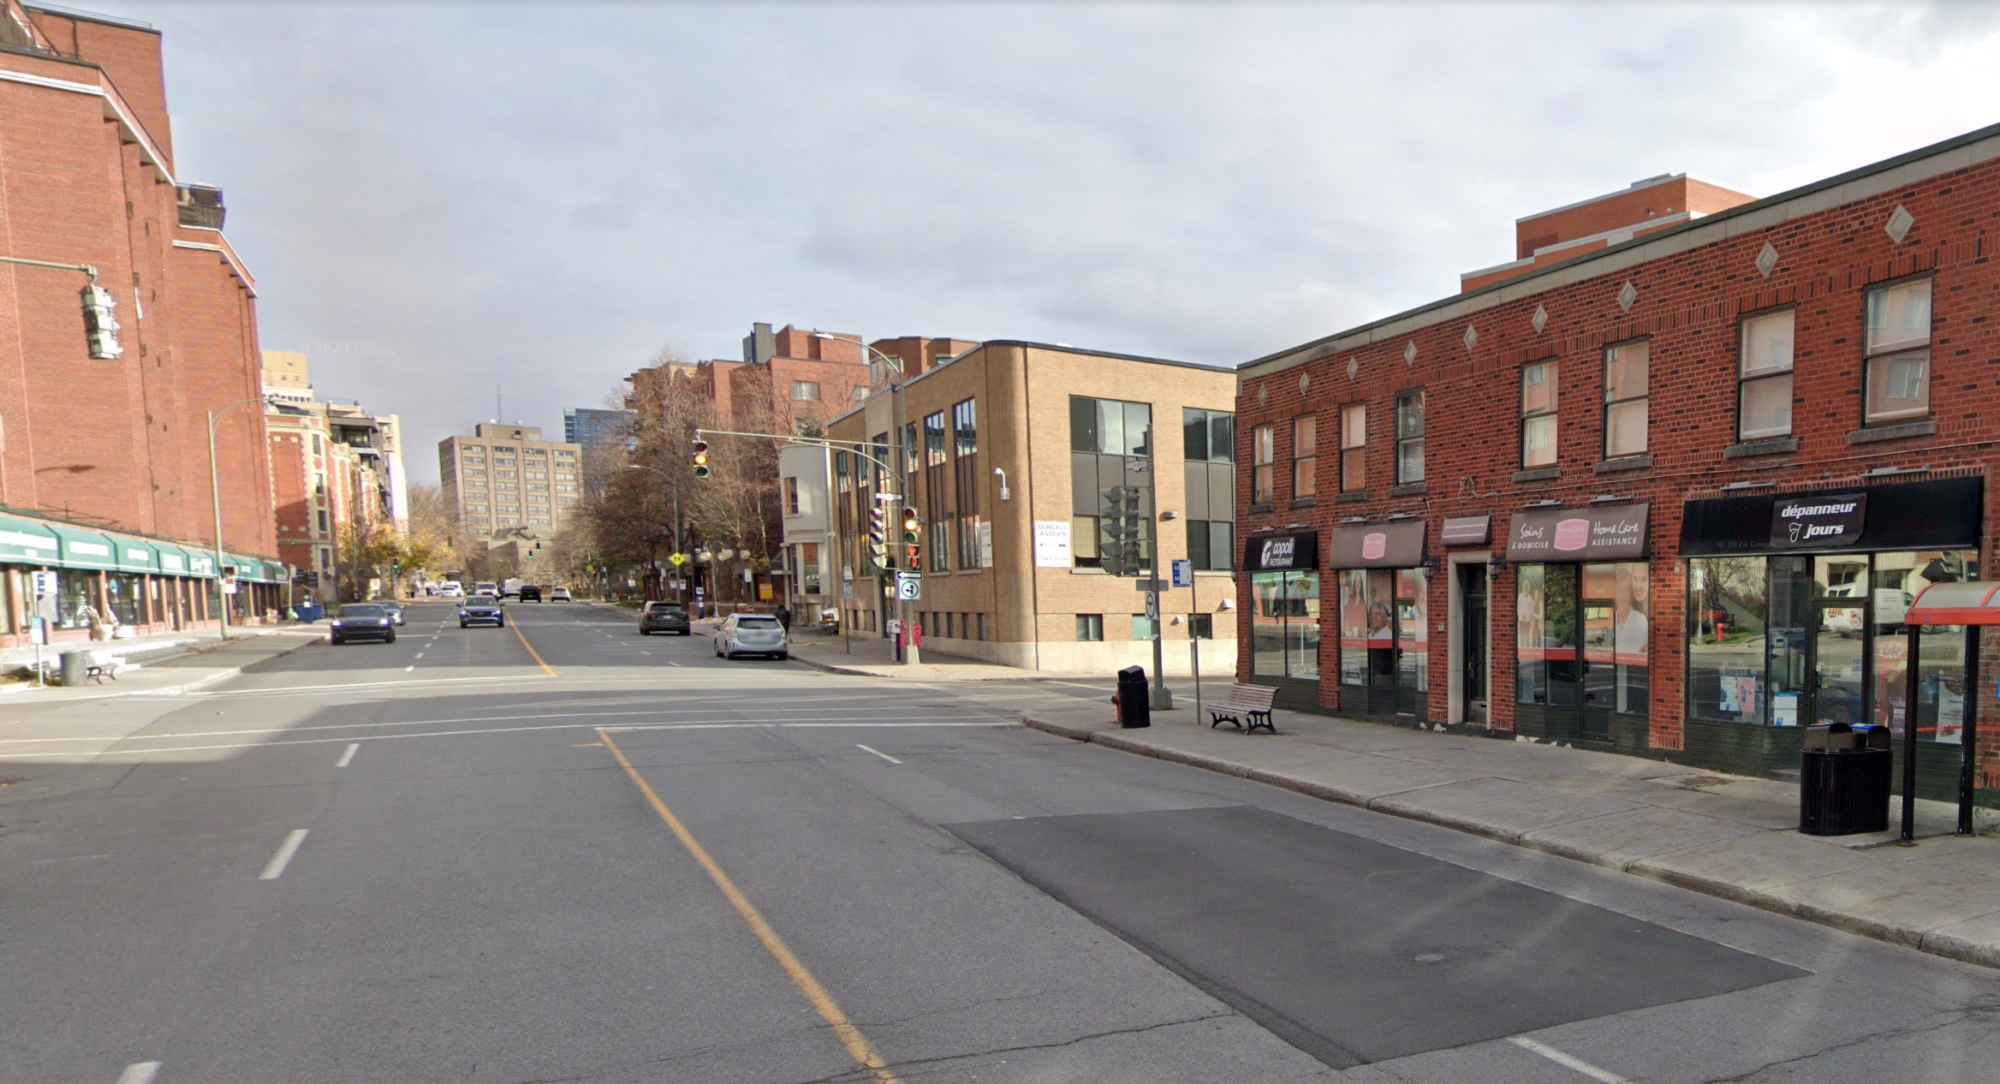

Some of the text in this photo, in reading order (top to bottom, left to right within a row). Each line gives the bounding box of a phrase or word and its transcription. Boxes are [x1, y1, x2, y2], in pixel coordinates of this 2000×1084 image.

[1781, 502, 1857, 519] dépanneur
[1519, 523, 1544, 539] Soins
[1592, 519, 1640, 535] Home Care
[1788, 522, 1802, 543] 7
[1802, 523, 1845, 540] jours
[1591, 536, 1637, 546] ASSISTANCE
